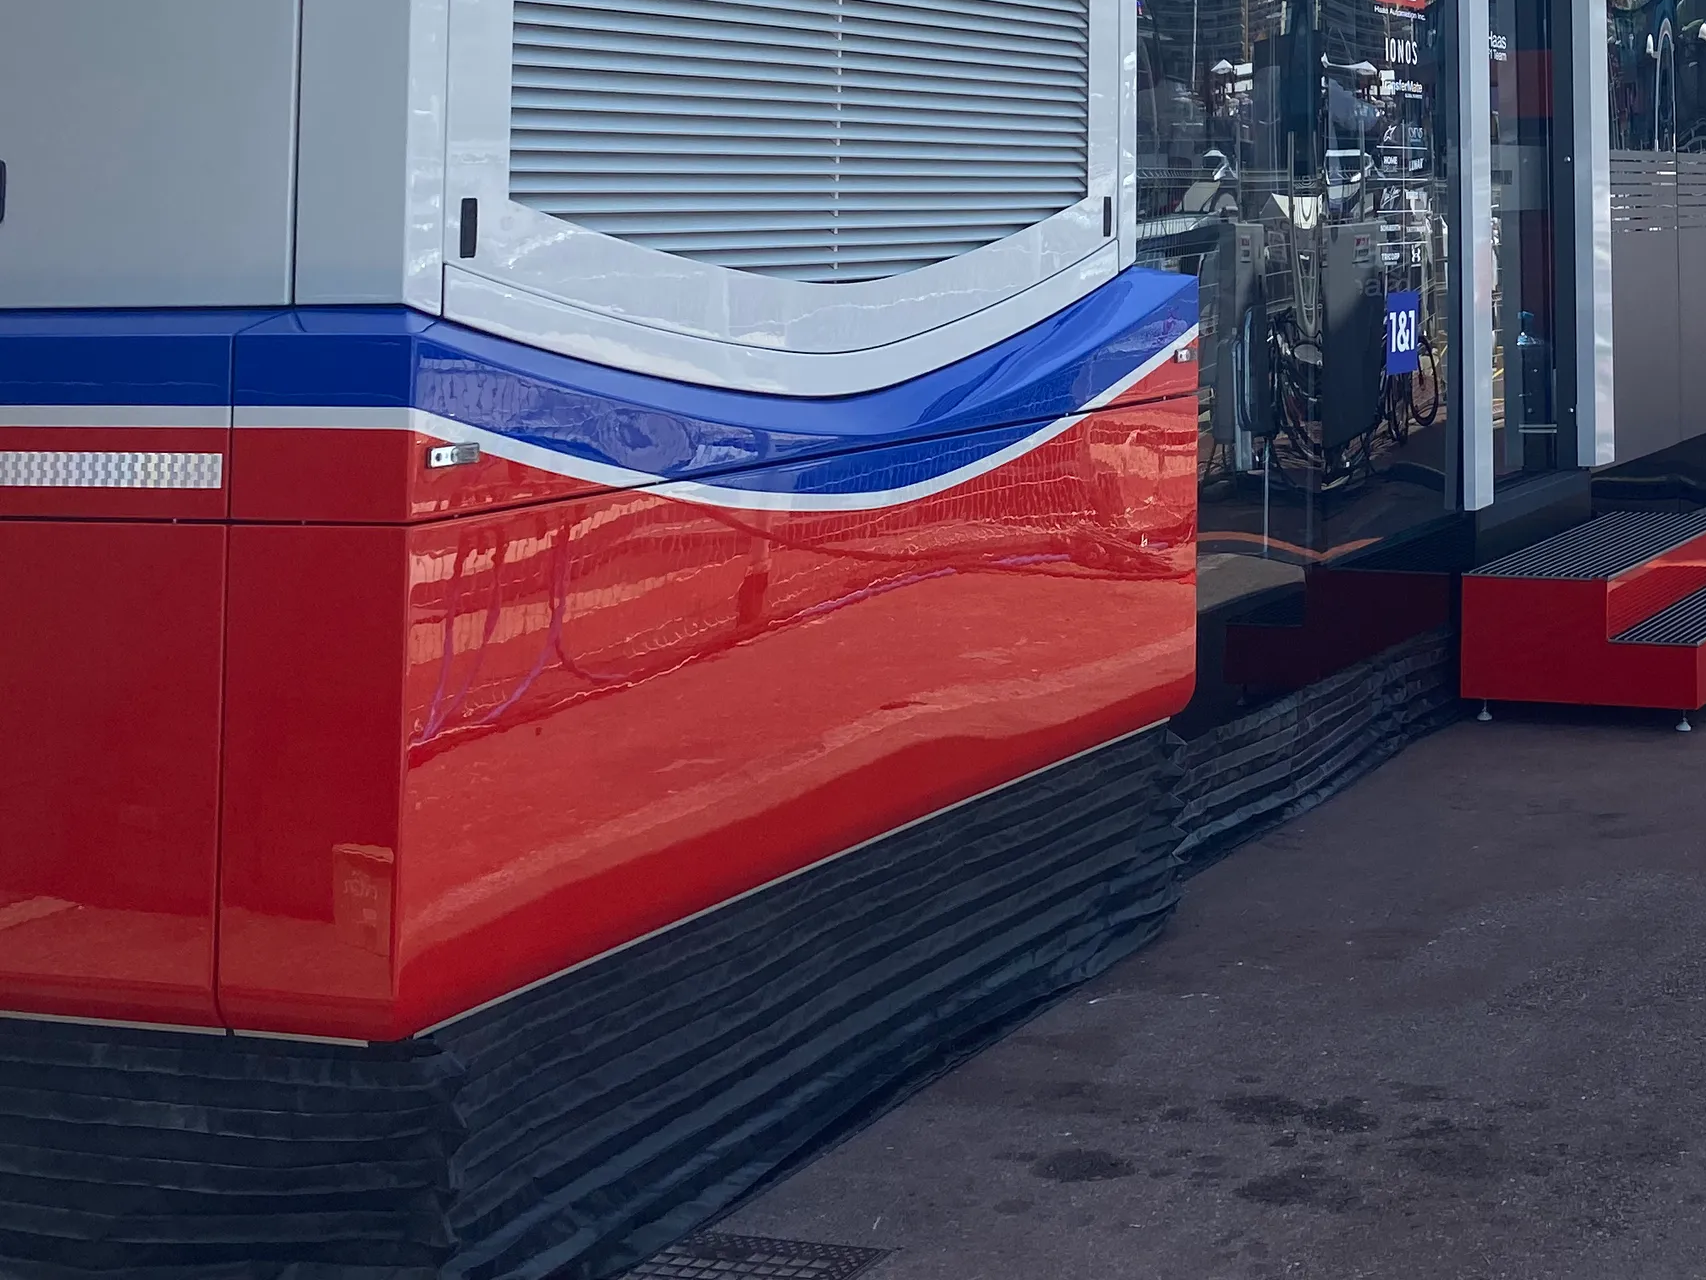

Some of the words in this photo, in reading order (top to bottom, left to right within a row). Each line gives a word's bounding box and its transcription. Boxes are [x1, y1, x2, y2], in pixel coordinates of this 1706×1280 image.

[1374, 5, 1389, 15] Haas
[1389, 7, 1417, 19] Automation
[1385, 37, 1418, 66] IONOS
[1381, 79, 1423, 94] TransferMate
[1389, 310, 1416, 353] 1&1
